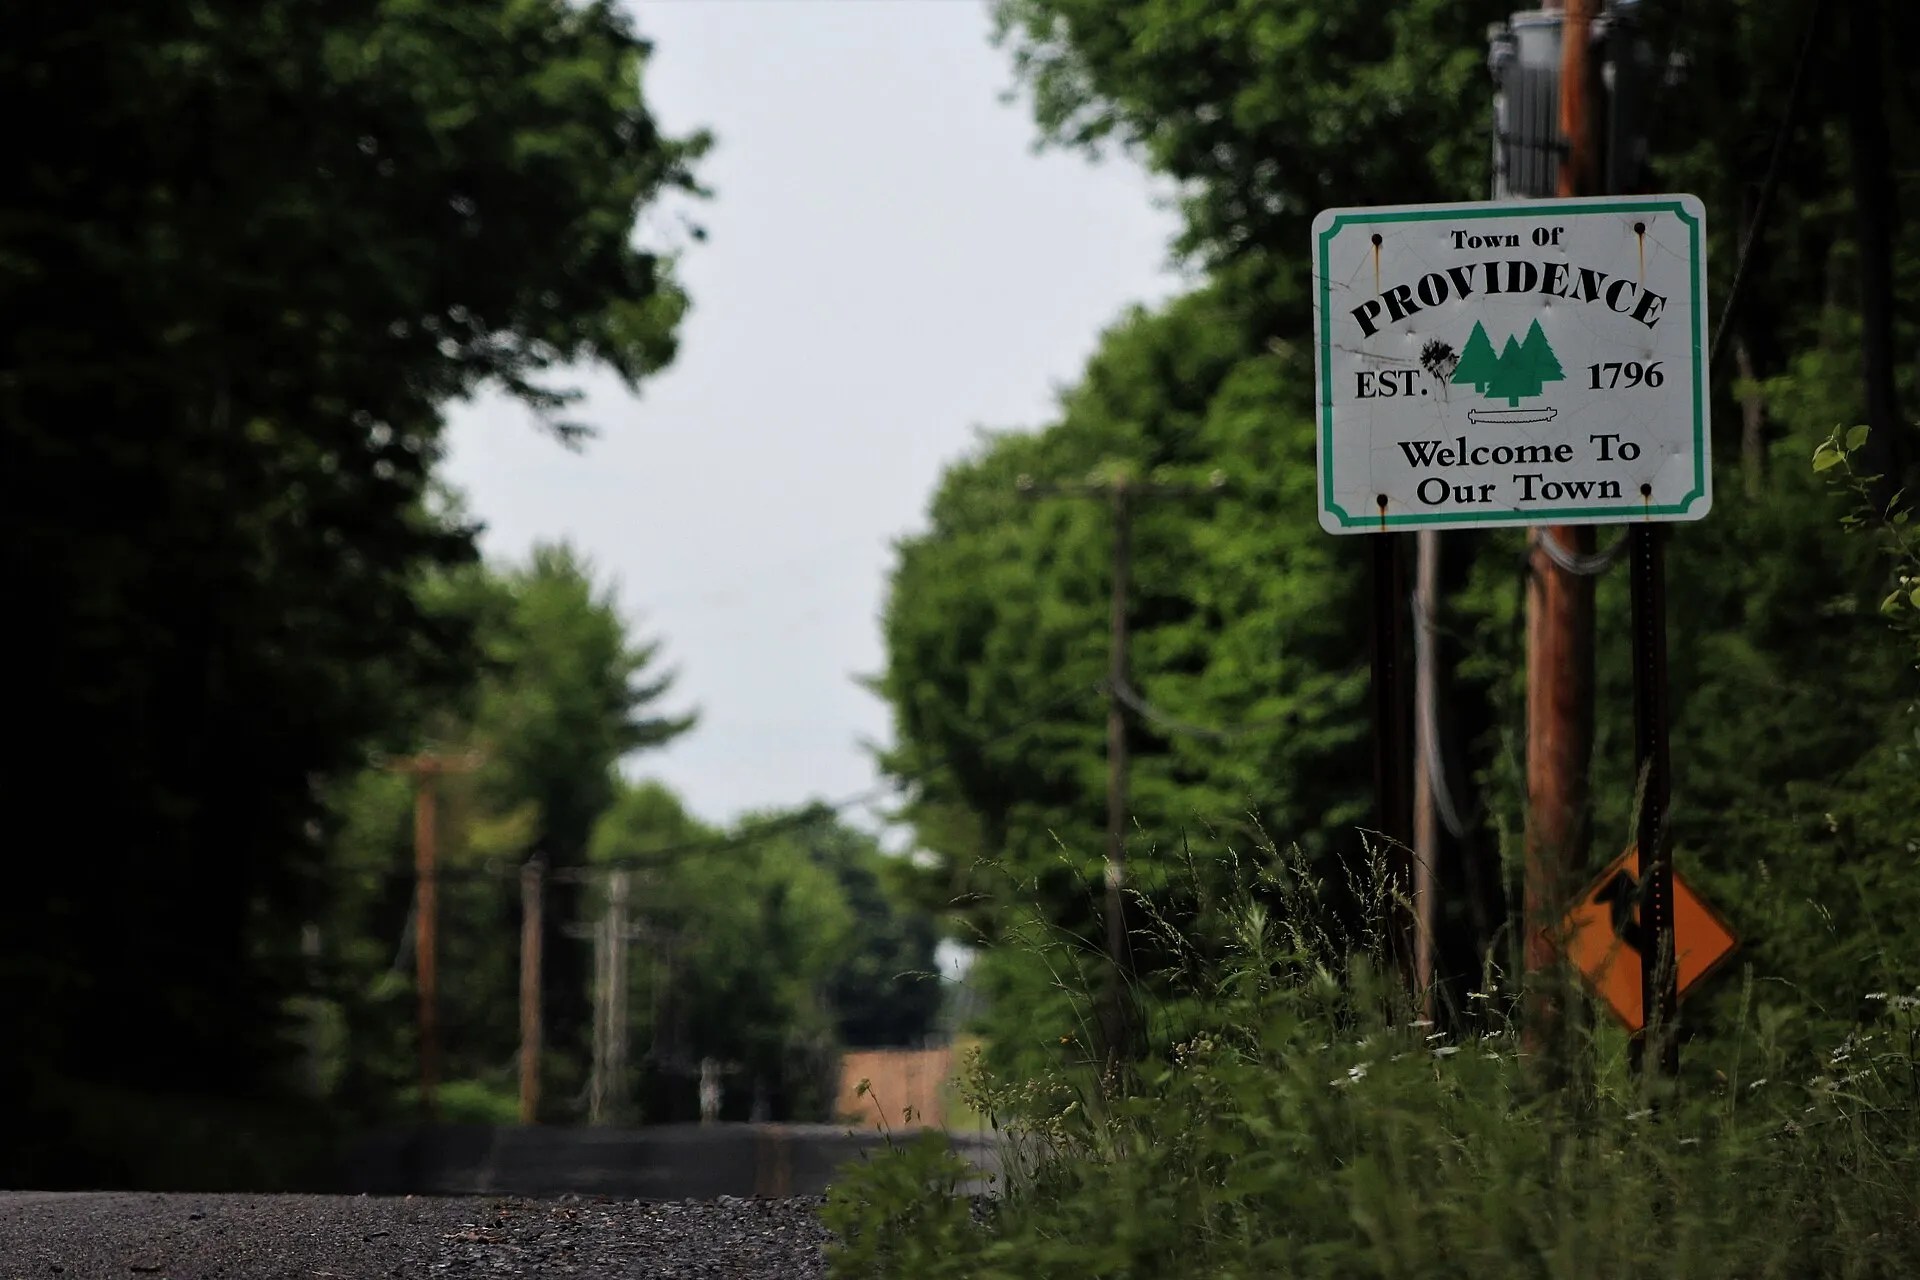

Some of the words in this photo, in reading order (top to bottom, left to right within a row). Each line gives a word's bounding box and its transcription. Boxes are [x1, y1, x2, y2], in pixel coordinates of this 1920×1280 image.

[1450, 229, 1520, 250] Town
[1532, 226, 1564, 247] Of
[1350, 260, 1668, 339] PROVIDENCE
[1354, 369, 1428, 399] EST.
[1587, 361, 1664, 390] 1796
[1398, 436, 1574, 468] Welcome
[1589, 434, 1641, 462] To
[1416, 477, 1496, 505] Our
[1513, 473, 1622, 503] Town
